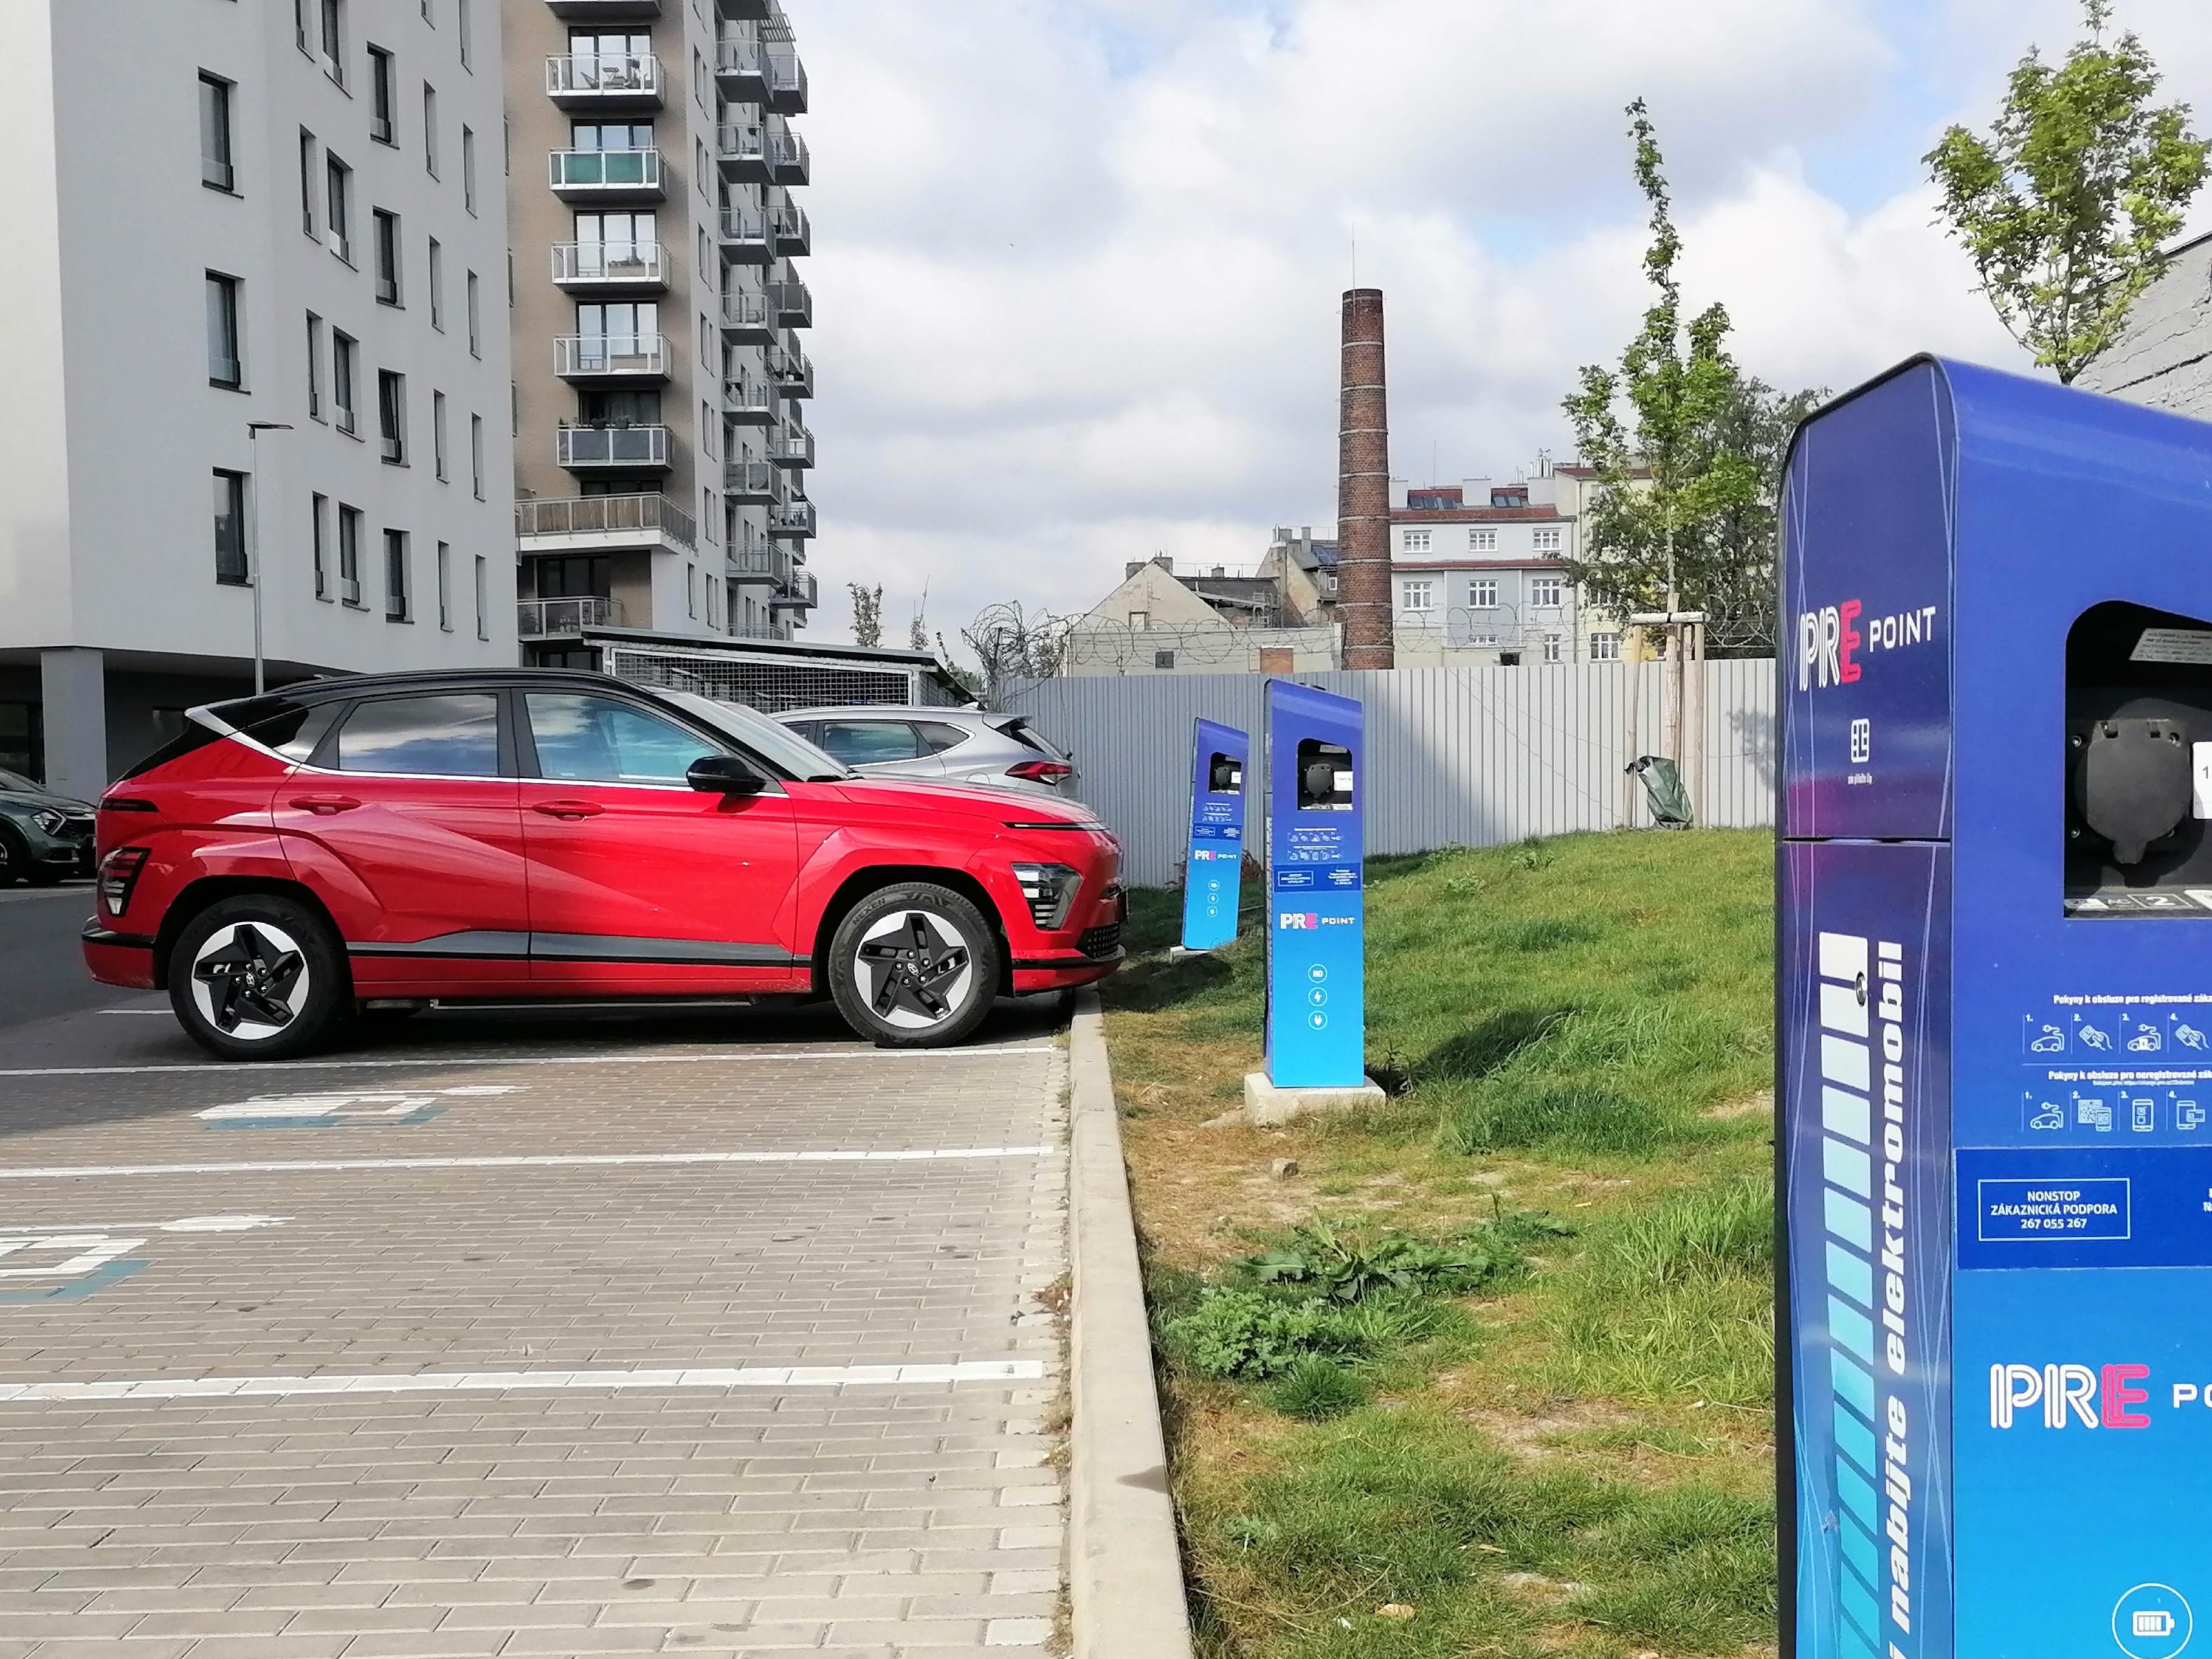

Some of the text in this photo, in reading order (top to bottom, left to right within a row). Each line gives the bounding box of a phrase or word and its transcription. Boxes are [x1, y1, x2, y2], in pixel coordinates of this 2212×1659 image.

[1799, 599, 1937, 692] PRE POINT
[2146, 896, 2175, 906] 2
[1280, 912, 1318, 930] PRE
[2053, 995, 2084, 1005] Pokyny
[2085, 995, 2091, 1004] k
[2125, 995, 2140, 1004] pro
[2048, 1071, 2078, 1081] Pokyny
[2079, 1070, 2086, 1080] k
[2120, 1072, 2135, 1081] pro
[1878, 940, 1906, 1375] elektromobil
[2027, 1190, 2081, 1202] NONSTOP
[1991, 1203, 2118, 1216] ZÁKAZNICKÁ PODPORA
[2021, 1218, 2087, 1229] 267 055 267
[1990, 1363, 2151, 1429] PRE
[1885, 1395, 1911, 1635] nabijte
